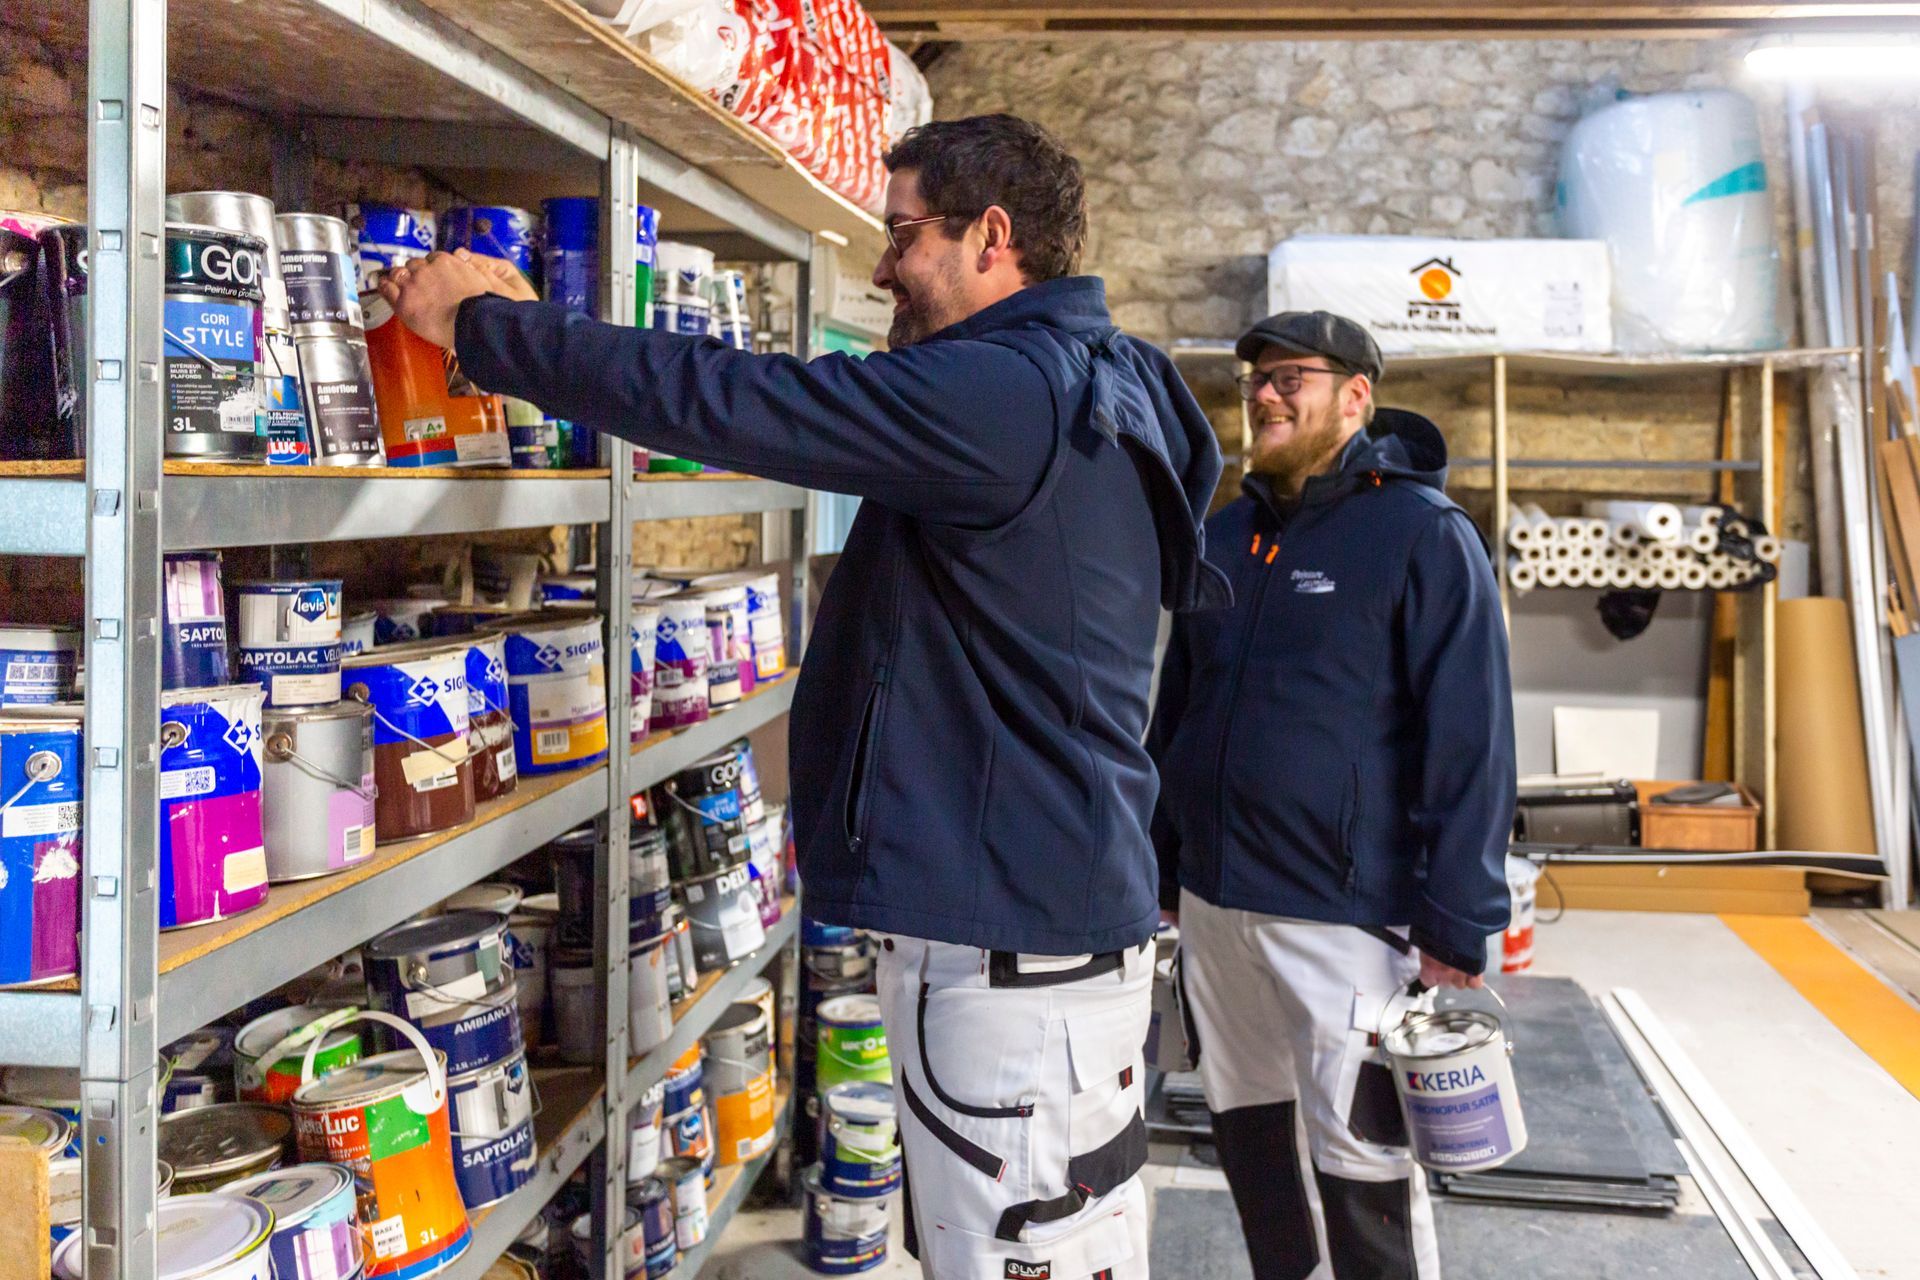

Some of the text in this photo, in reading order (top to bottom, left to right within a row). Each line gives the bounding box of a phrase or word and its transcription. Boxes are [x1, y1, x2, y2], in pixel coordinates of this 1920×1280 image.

[205, 284, 237, 296] Peinture
[201, 312, 230, 326] GORI
[182, 326, 245, 347] STYLE
[173, 416, 196, 431] 3L
[426, 422, 443, 433] A+
[297, 595, 325, 613] levis
[565, 639, 602, 658] SIGMA
[1420, 1064, 1485, 1092] KERIA
[1471, 1092, 1499, 1111] SATIN
[462, 1126, 529, 1168] SAPTOLAC
